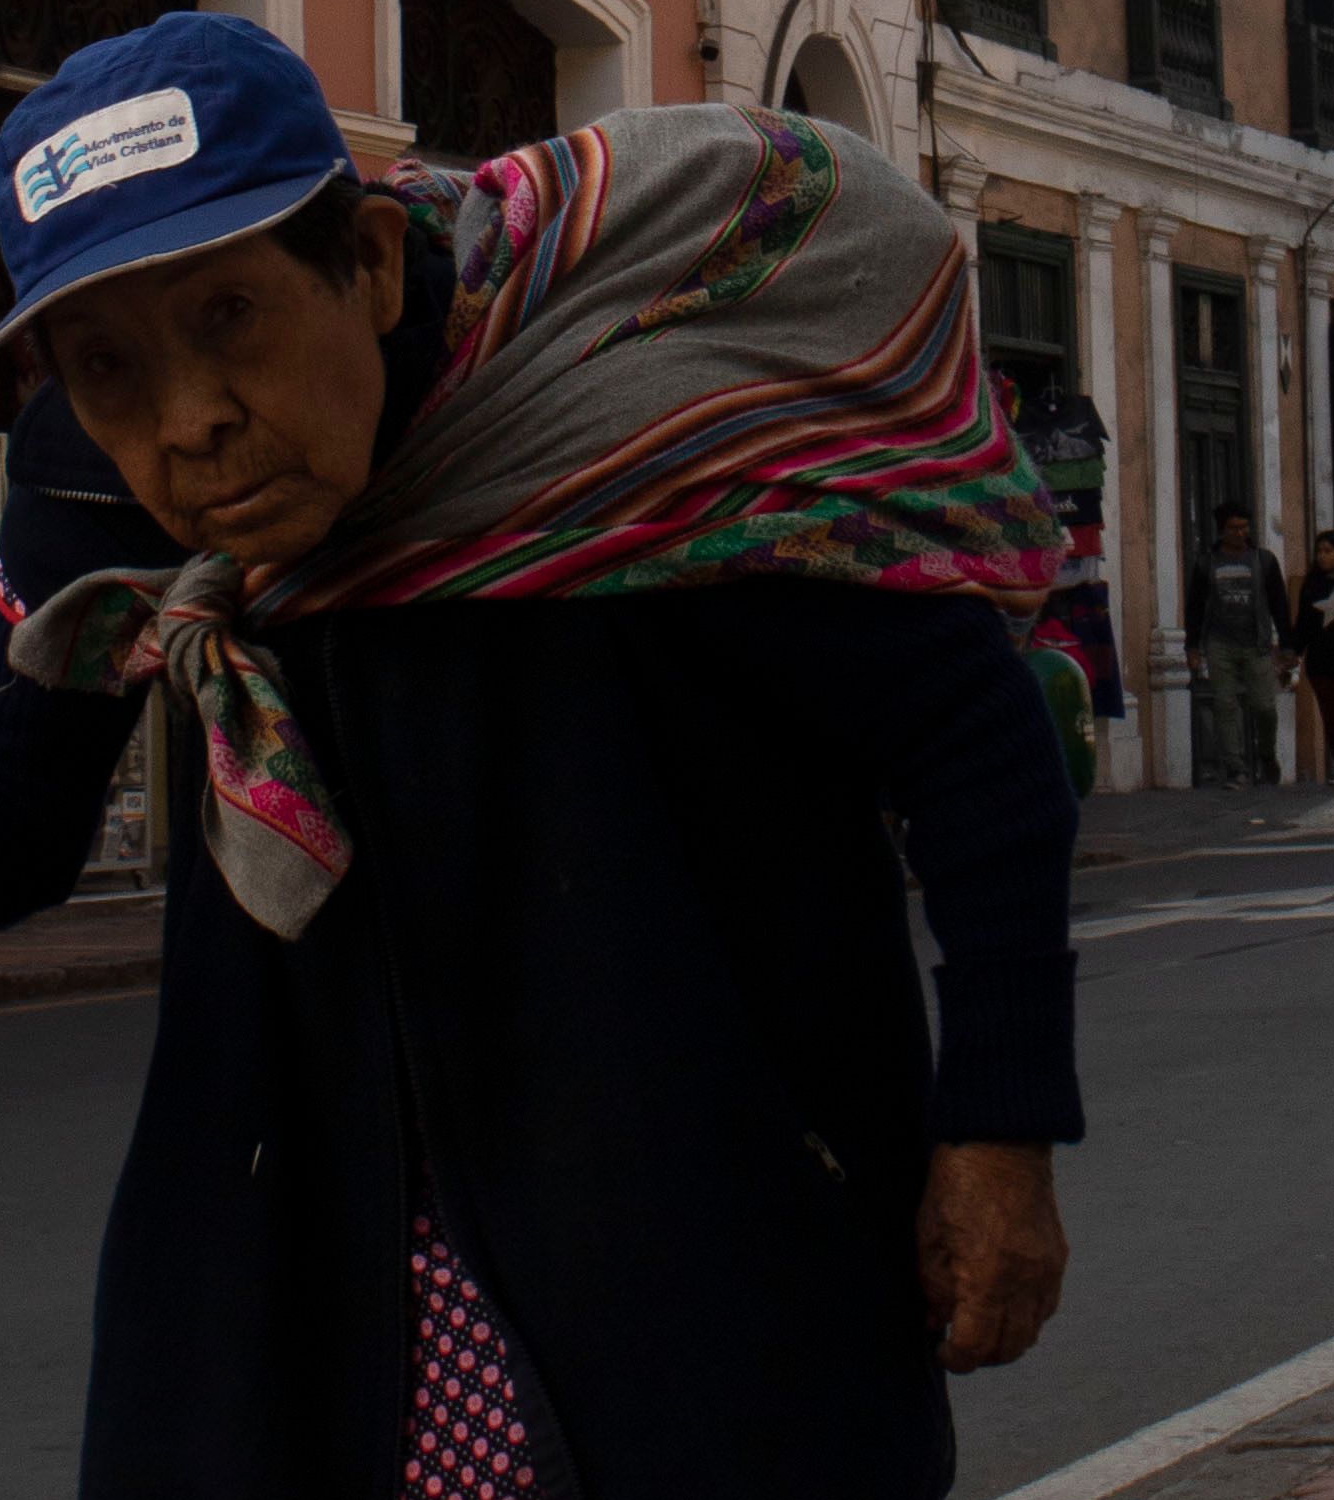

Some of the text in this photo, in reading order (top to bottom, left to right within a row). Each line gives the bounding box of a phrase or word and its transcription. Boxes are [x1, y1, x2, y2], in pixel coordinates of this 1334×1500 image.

[84, 115, 186, 155] Movimiento de
[86, 134, 182, 169] Vida Cristiana
